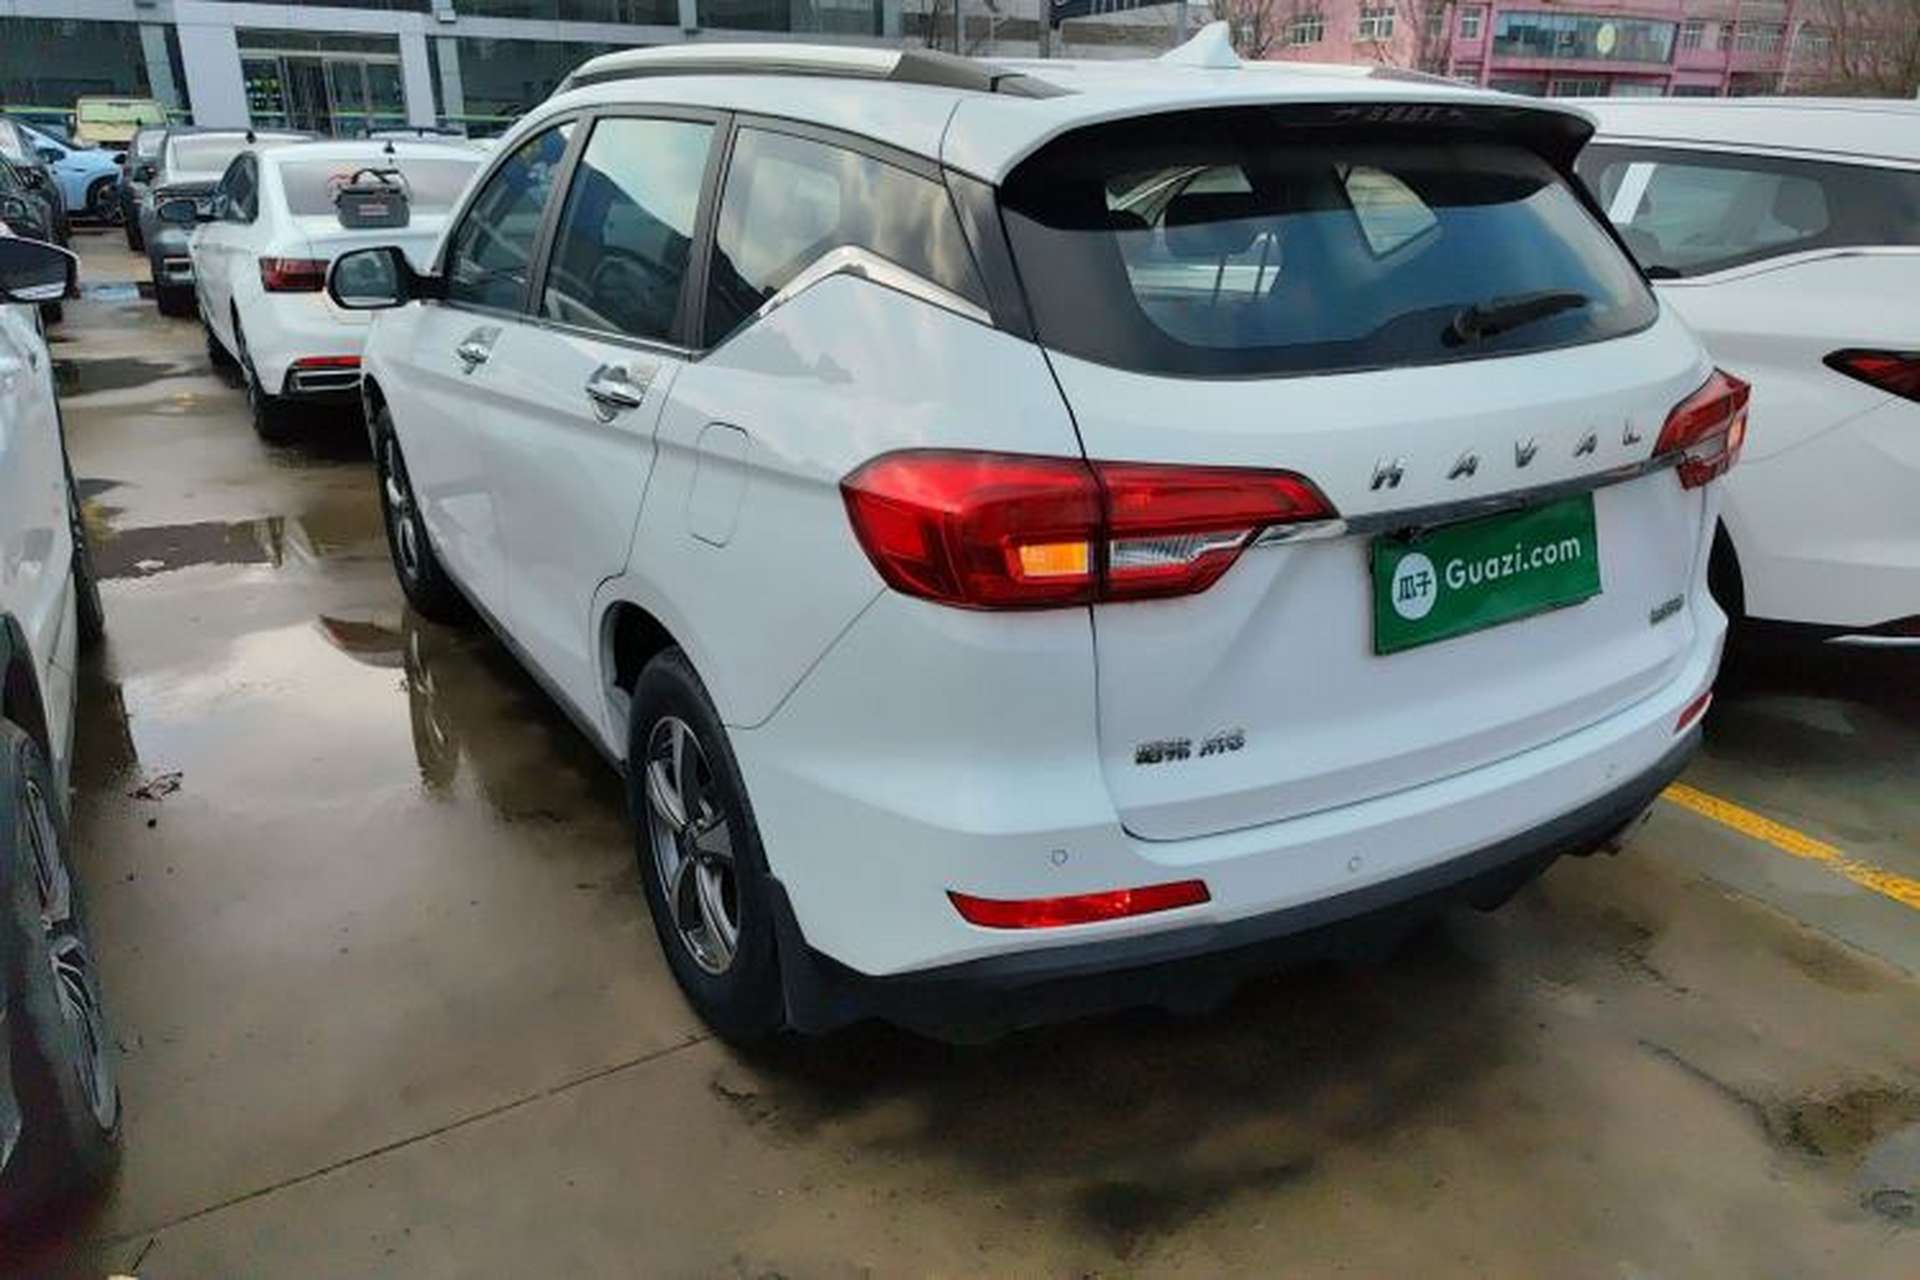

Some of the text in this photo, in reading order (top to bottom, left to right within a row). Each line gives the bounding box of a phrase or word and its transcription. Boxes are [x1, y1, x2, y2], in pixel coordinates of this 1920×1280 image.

[1370, 420, 1641, 491] HAVAL
[1399, 570, 1431, 601] 瓜子
[1446, 537, 1581, 590] Guazi.com
